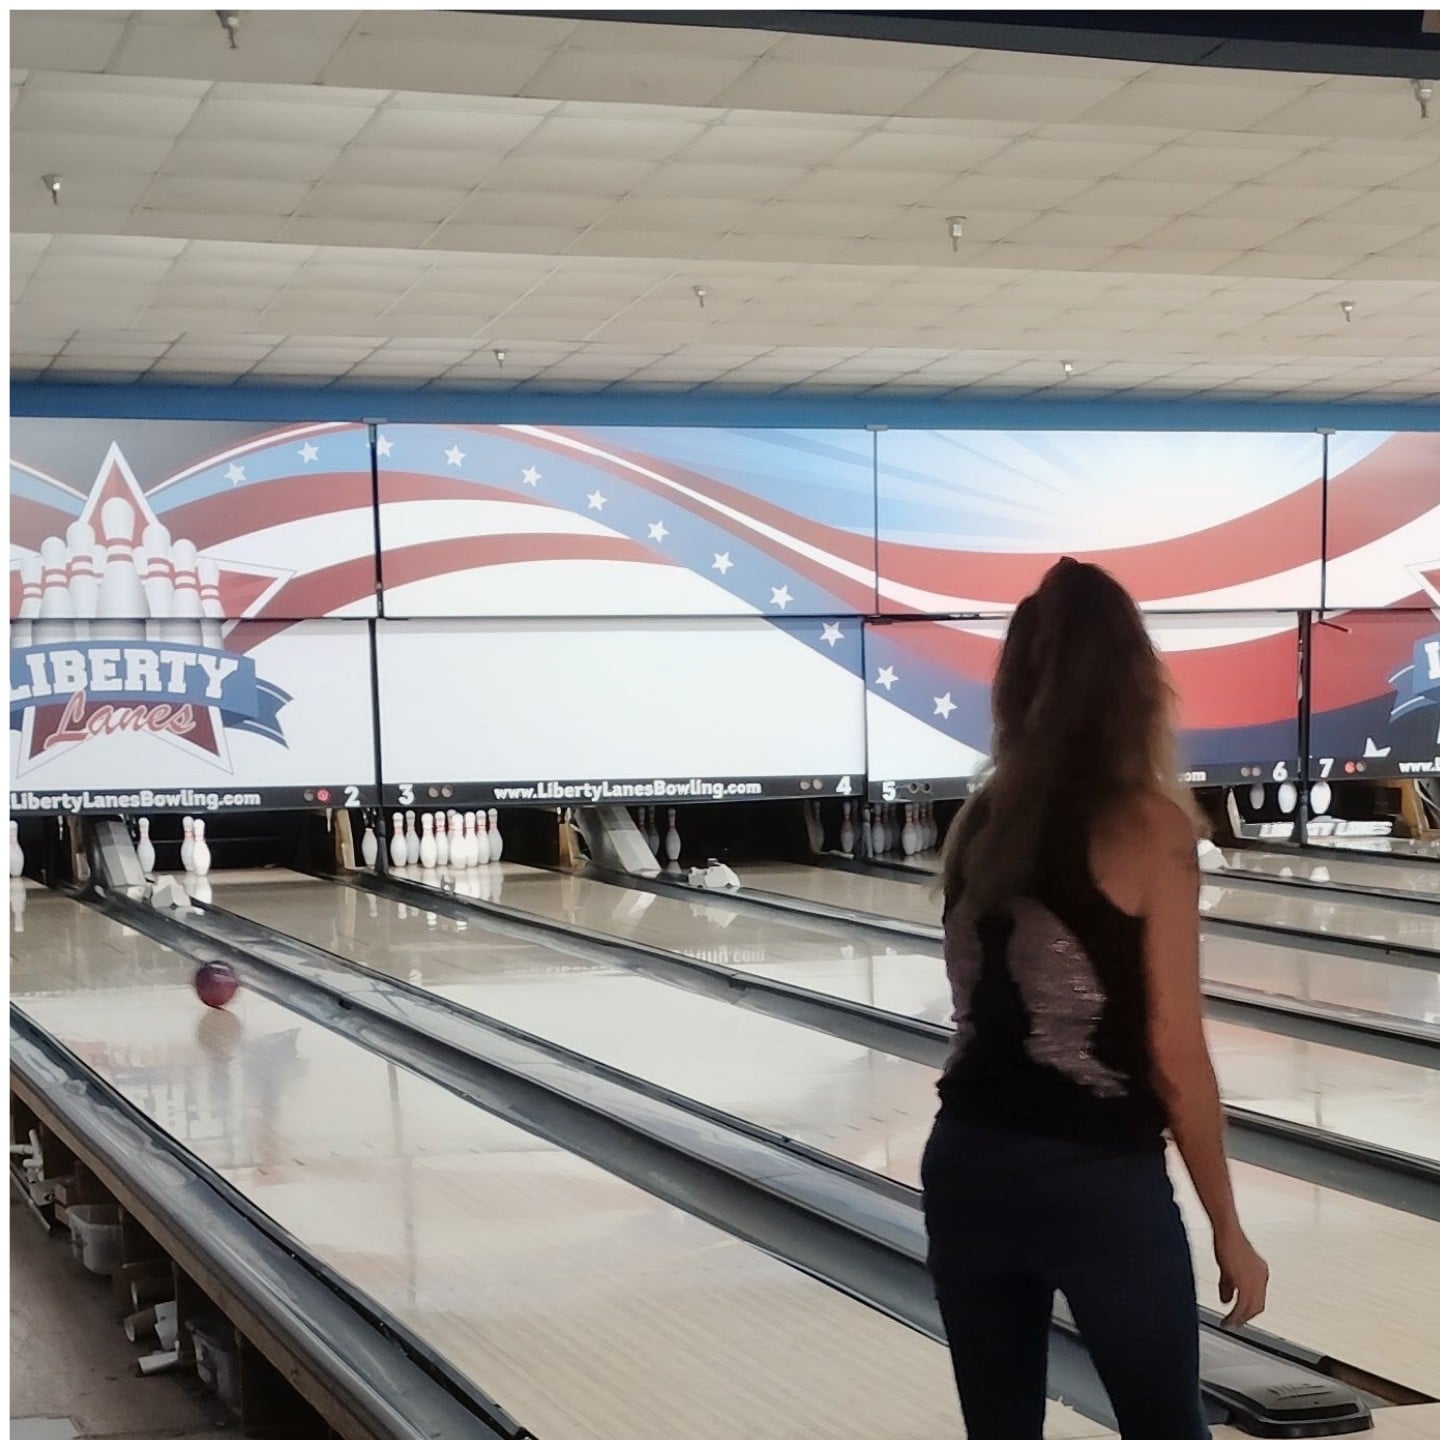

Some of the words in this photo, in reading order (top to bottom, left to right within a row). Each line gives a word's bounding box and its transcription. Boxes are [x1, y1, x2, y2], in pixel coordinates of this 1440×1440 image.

[44, 690, 197, 749] Lanes
[1273, 762, 1287, 781] 6
[1319, 758, 1333, 776] 7
[399, 784, 415, 805] 3
[494, 779, 762, 801] www.LibertyLanesBowling.com
[835, 775, 852, 795] 4
[882, 781, 896, 800] 5
[345, 785, 360, 806] 2
